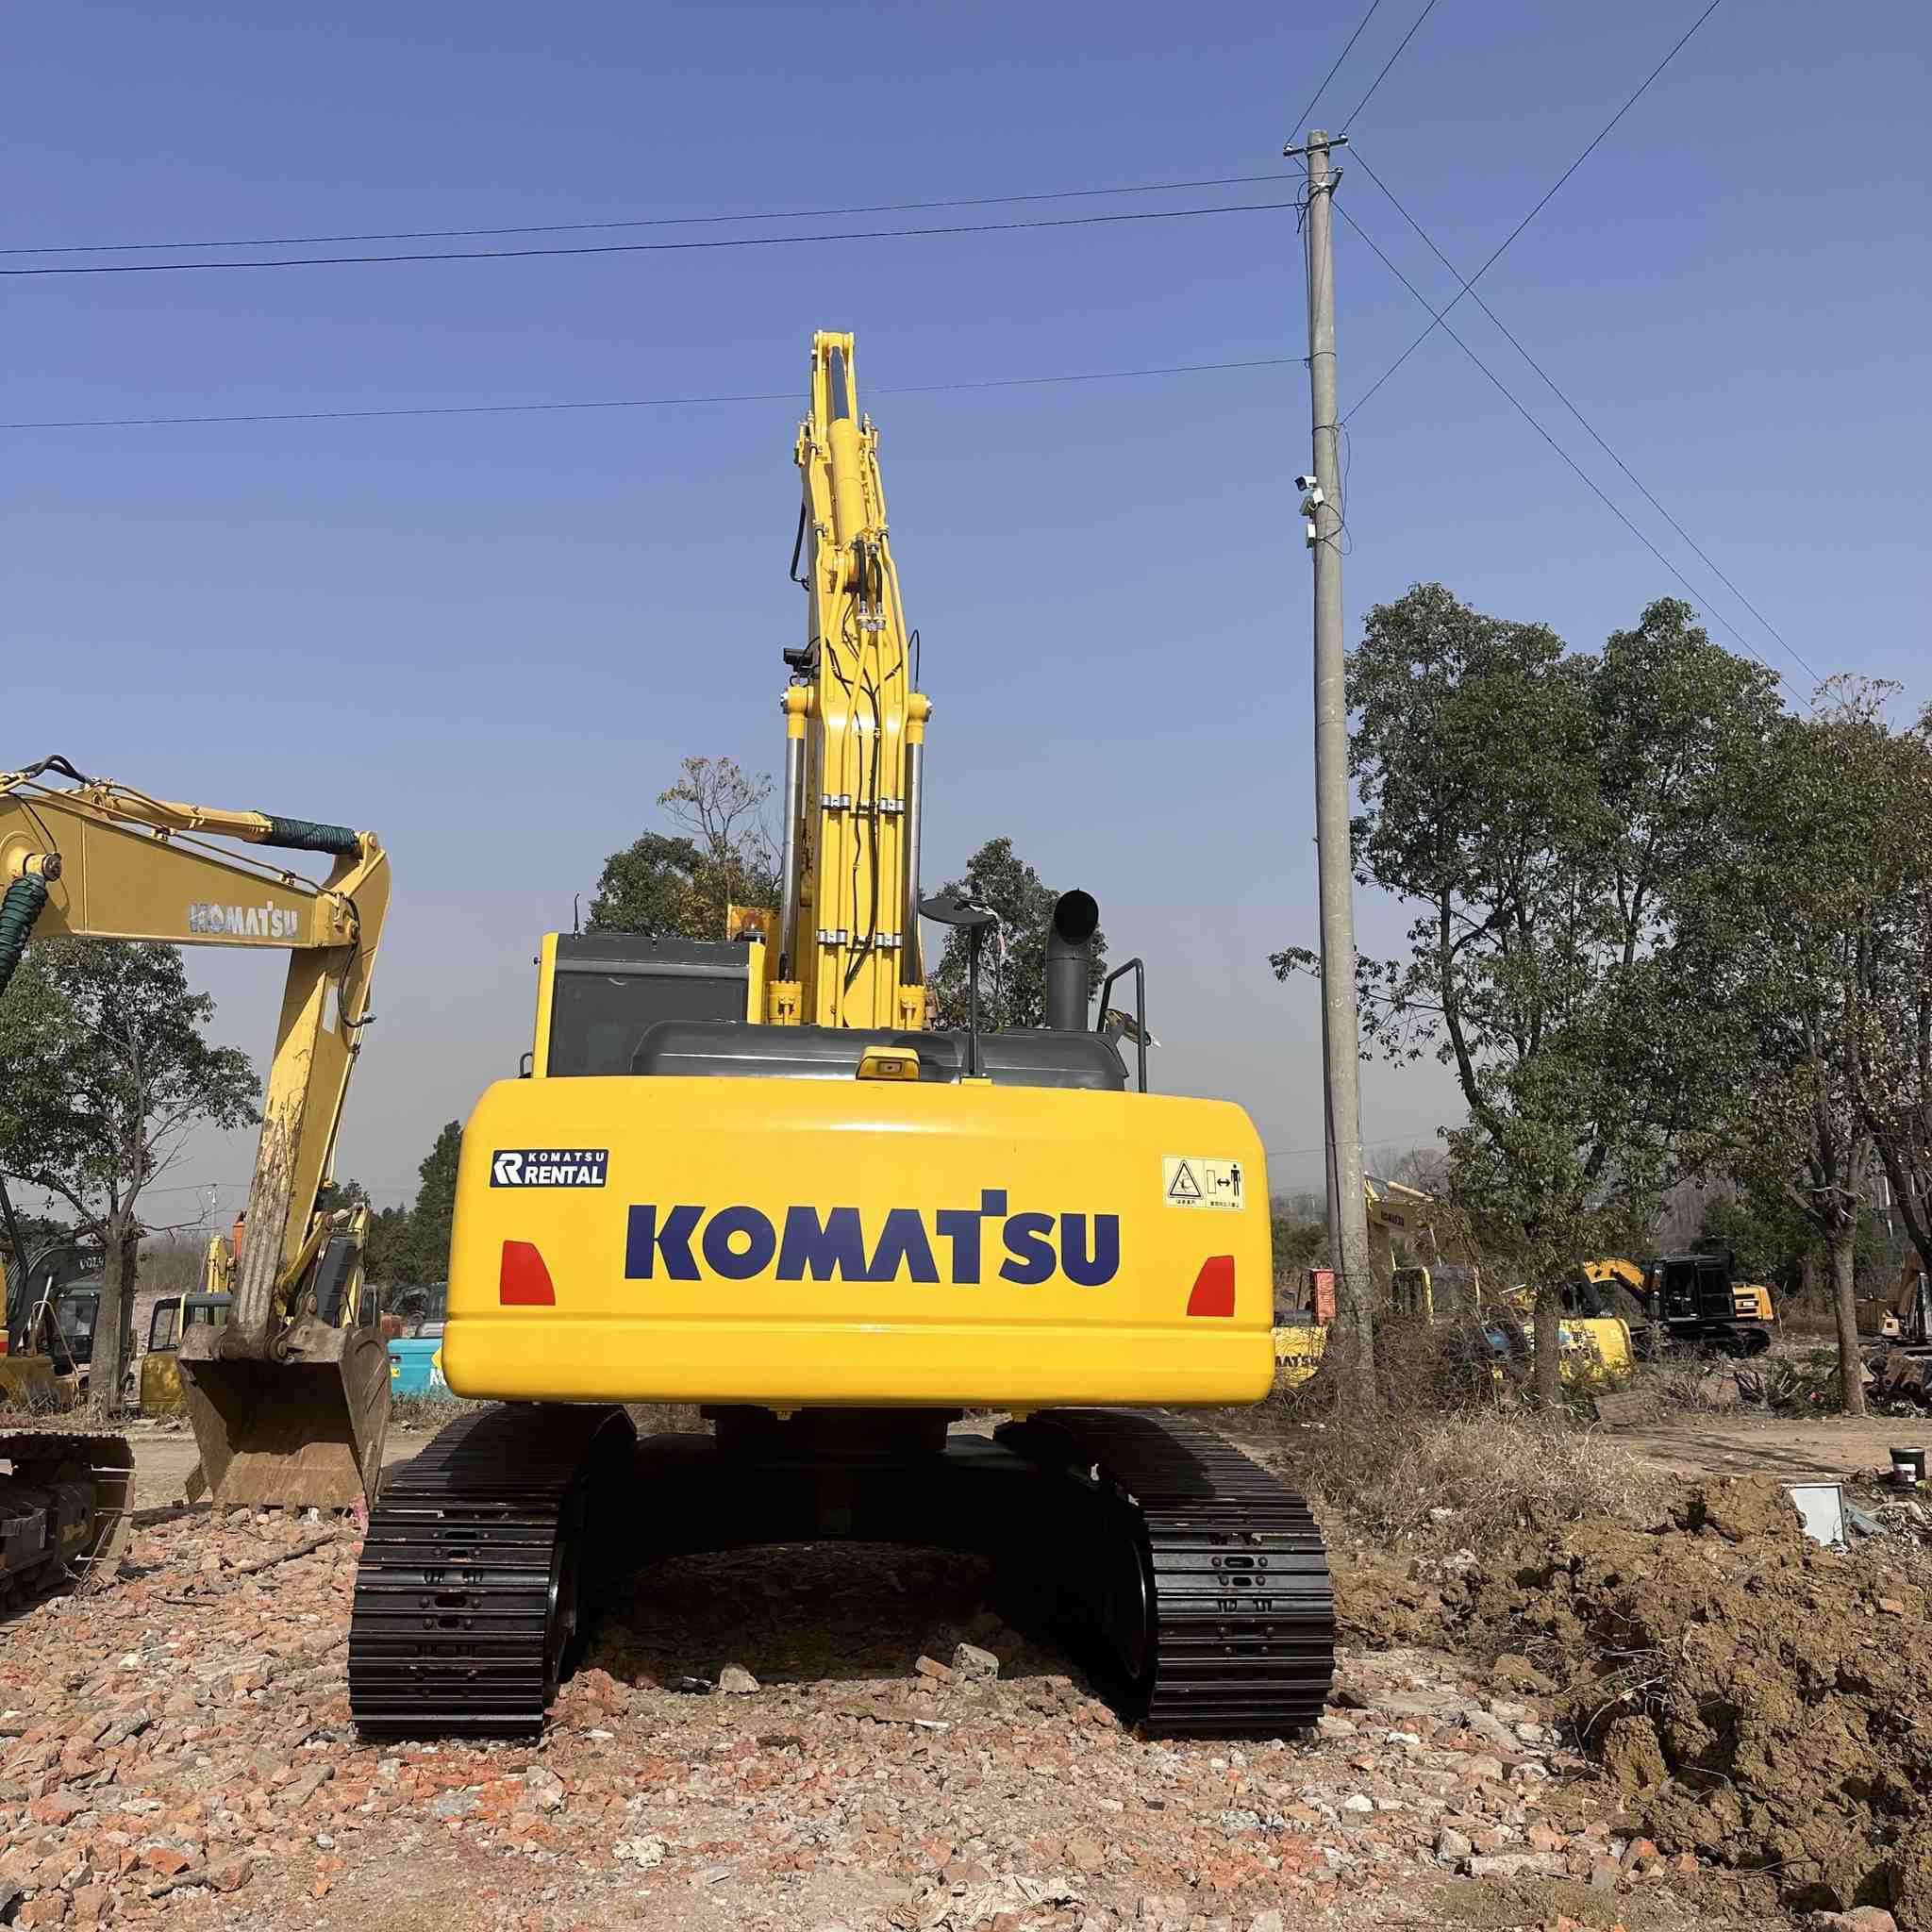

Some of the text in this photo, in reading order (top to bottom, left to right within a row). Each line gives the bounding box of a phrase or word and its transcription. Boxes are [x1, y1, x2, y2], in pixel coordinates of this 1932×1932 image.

[190, 900, 298, 937] KOMATSU
[528, 1152, 605, 1162] KOMATSU
[525, 1166, 604, 1185] RENTAL
[625, 1189, 1121, 1287] KOMATSU
